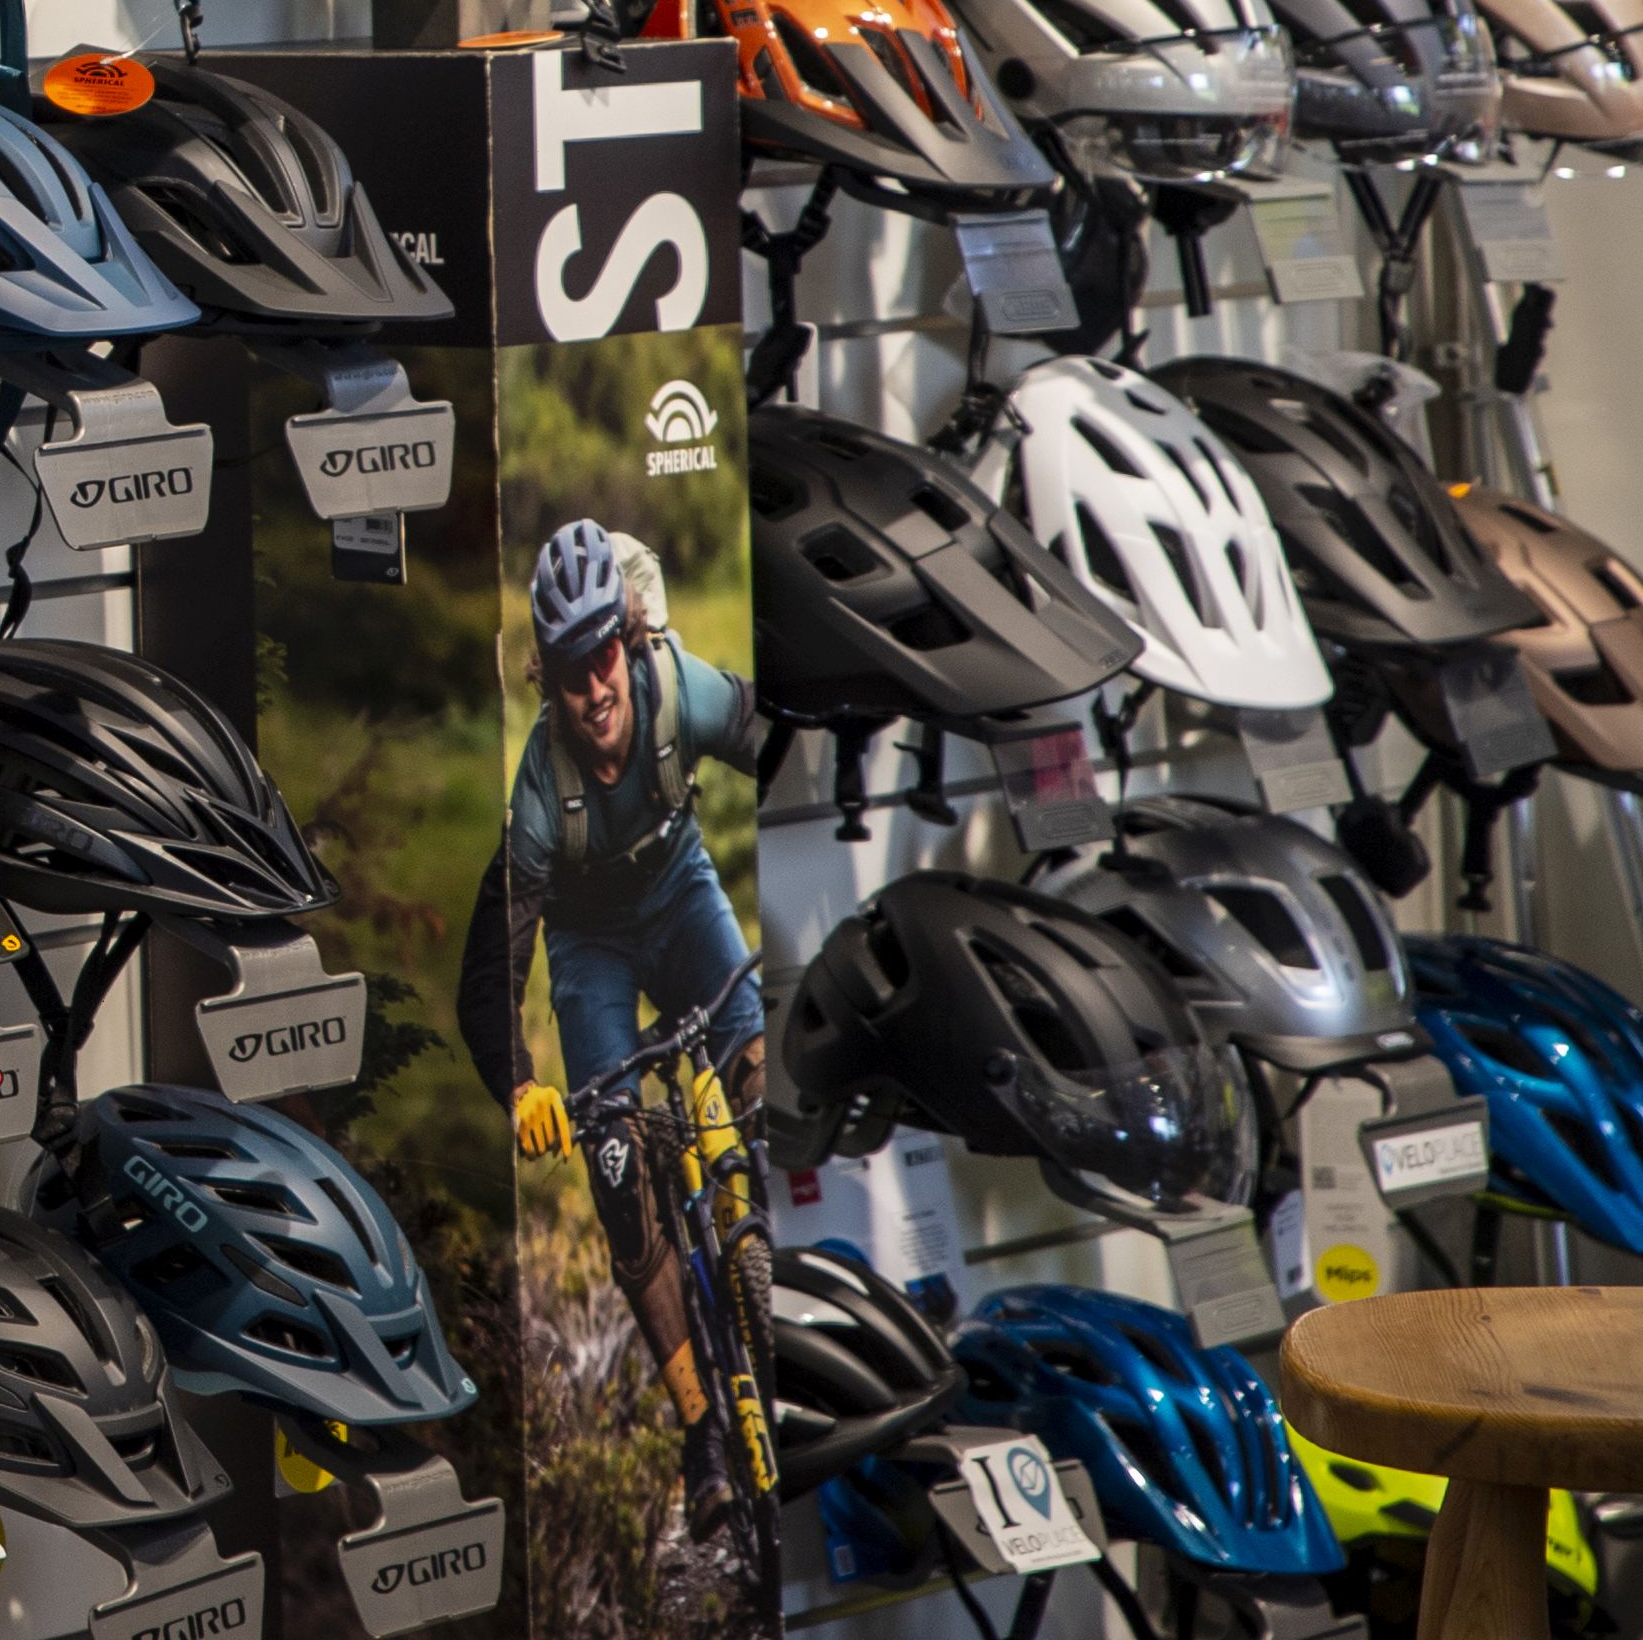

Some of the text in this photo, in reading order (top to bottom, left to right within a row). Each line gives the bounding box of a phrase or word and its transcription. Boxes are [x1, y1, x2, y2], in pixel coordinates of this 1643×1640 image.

[74, 76, 124, 87] SPHERICAL
[357, 441, 435, 474] GIRO
[646, 446, 716, 474] SPHERICAL
[111, 467, 192, 502] GIRO
[265, 1018, 346, 1052] GIRO
[124, 1155, 207, 1231] GIRO
[1325, 1264, 1372, 1284] Mips
[408, 1543, 486, 1587] GIRO
[163, 1598, 245, 1640] GIRO
